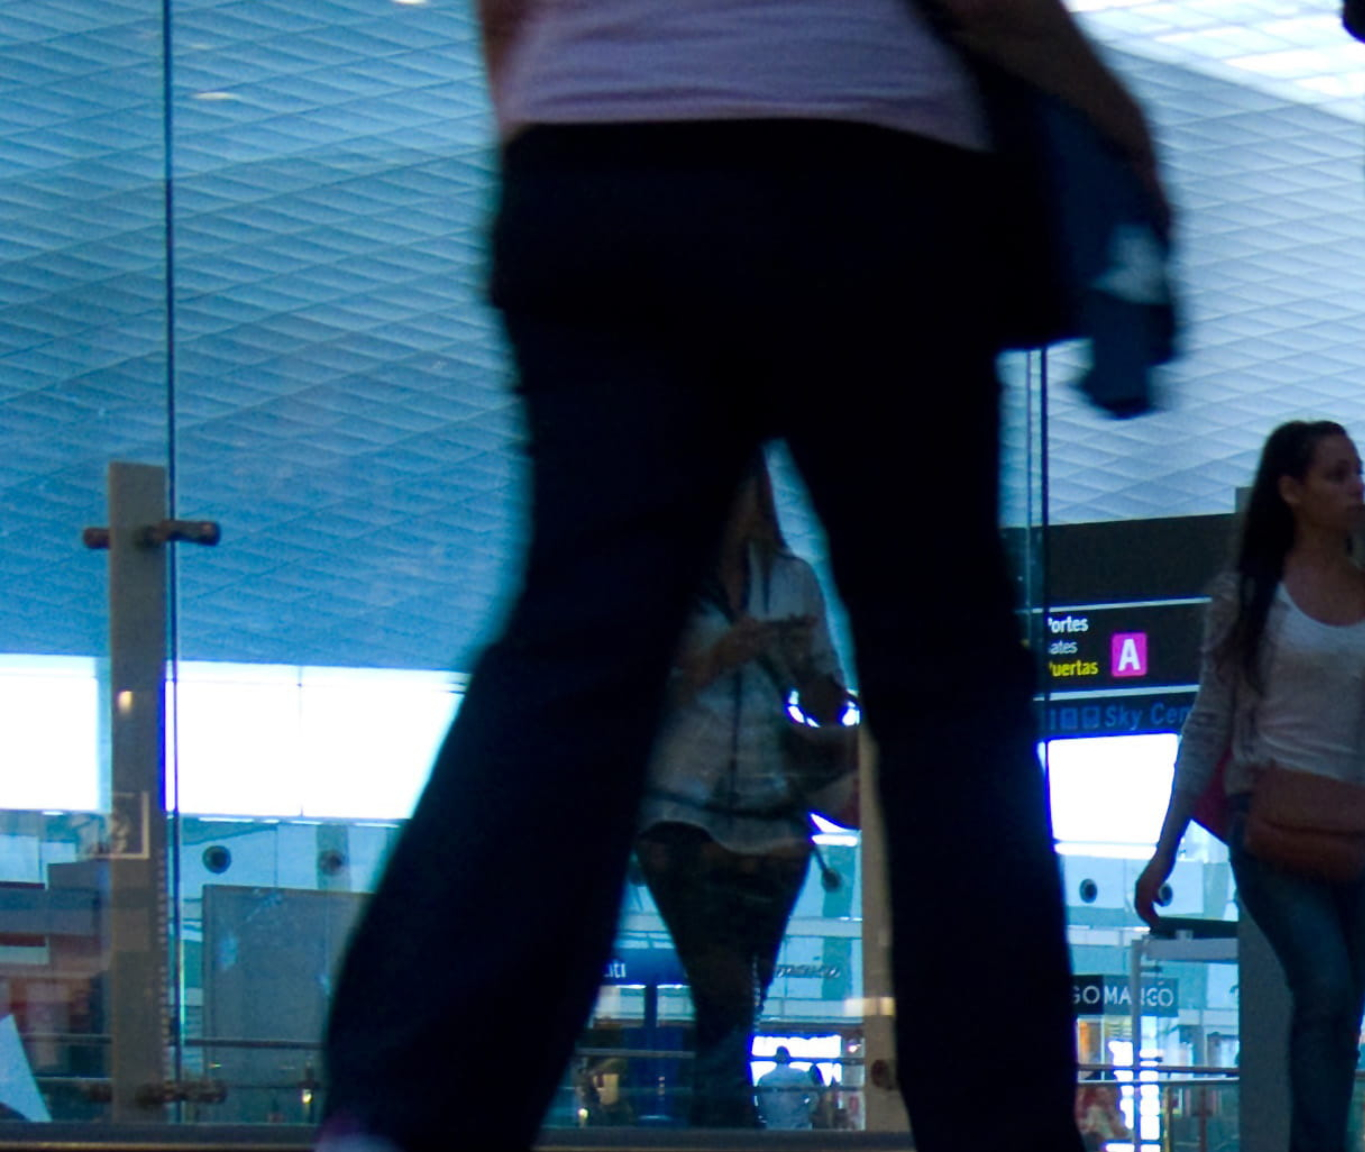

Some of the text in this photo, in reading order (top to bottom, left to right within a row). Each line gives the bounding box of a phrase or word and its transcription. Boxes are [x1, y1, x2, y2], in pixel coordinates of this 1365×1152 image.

[1048, 615, 1089, 633] ortes
[1049, 640, 1078, 655] ates
[1117, 638, 1142, 672] A
[1050, 659, 1099, 677] uertas
